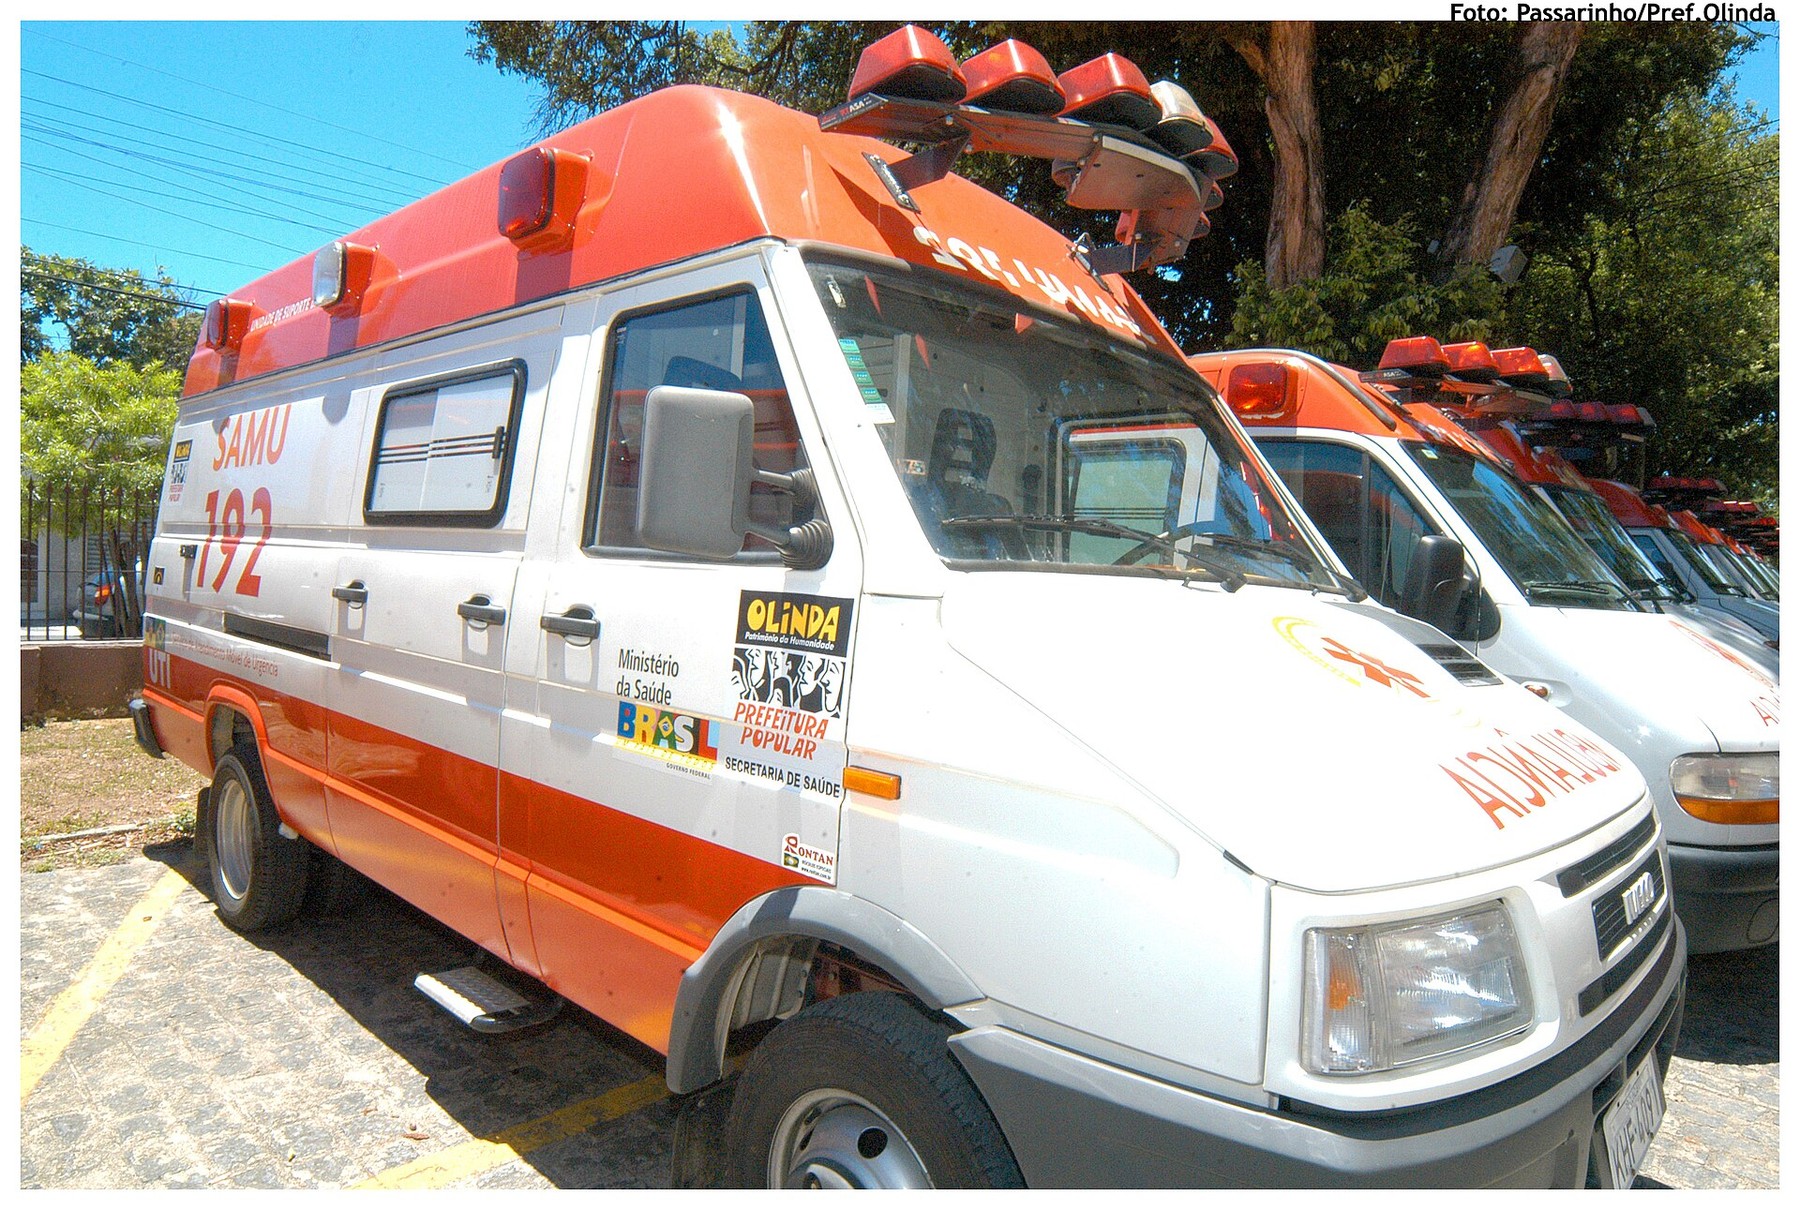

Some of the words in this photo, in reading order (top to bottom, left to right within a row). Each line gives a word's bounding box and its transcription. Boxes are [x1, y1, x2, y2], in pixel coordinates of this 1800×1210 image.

[213, 404, 292, 472] SAMU
[196, 486, 273, 598] 192
[745, 631, 779, 643] Patrimônio
[779, 634, 789, 644] da
[789, 636, 835, 651] Humanidade
[149, 647, 171, 689] UTI
[618, 648, 680, 678] Ministério
[616, 675, 631, 698] da
[634, 679, 672, 706] Saúde
[740, 726, 817, 760] POPULAR
[666, 762, 689, 774] GOVERNO
[689, 769, 711, 780] FEDERAL
[725, 756, 785, 783] SECRETARIA
[786, 771, 801, 788] DE
[803, 776, 841, 798] SAÚDE
